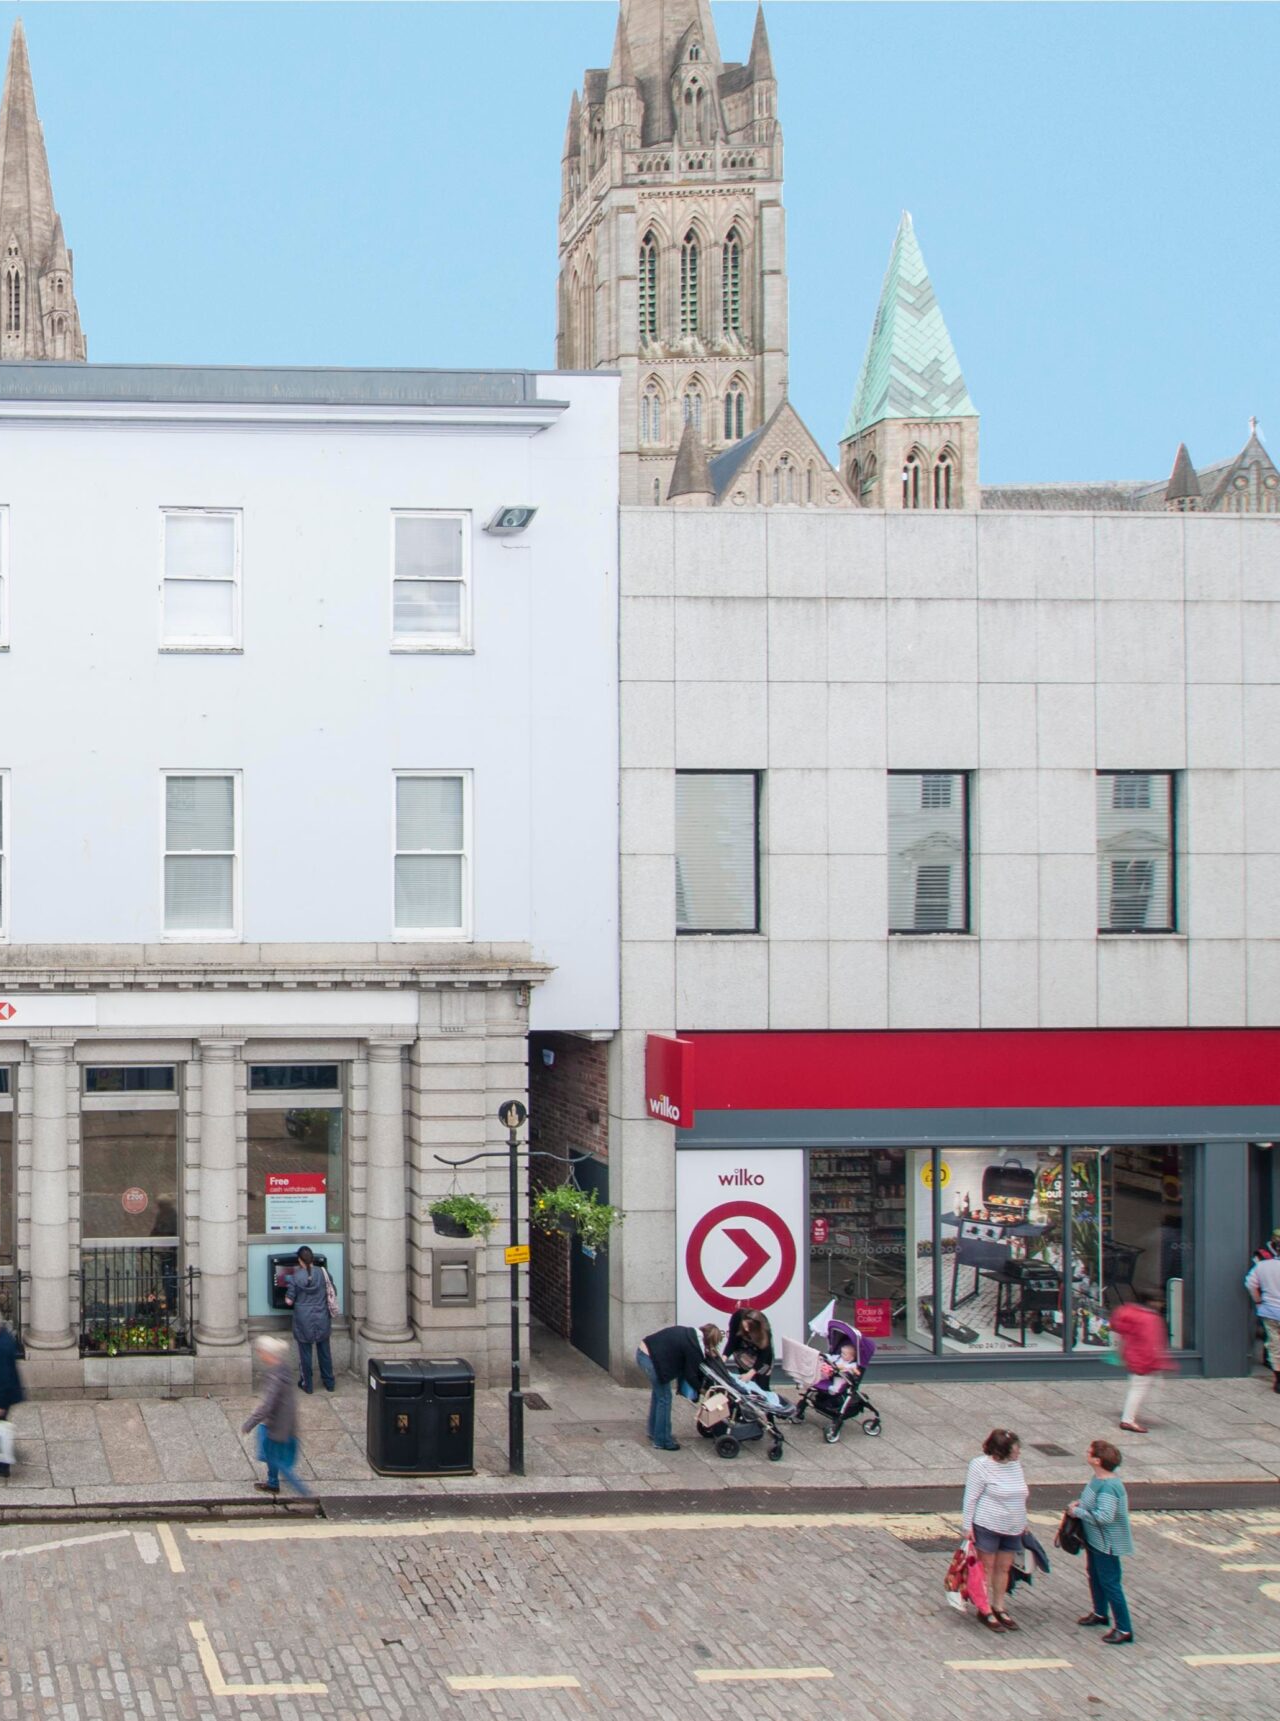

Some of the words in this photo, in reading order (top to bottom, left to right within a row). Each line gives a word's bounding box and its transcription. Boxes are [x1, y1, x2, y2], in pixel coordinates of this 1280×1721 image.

[650, 1095, 680, 1120] wilko
[718, 1168, 765, 1186] wilko
[924, 1168, 947, 1183] £0
[269, 1177, 290, 1186] Free
[1054, 1179, 1080, 1190] gat
[1046, 1190, 1089, 1198] outors
[856, 1308, 877, 1316] Order
